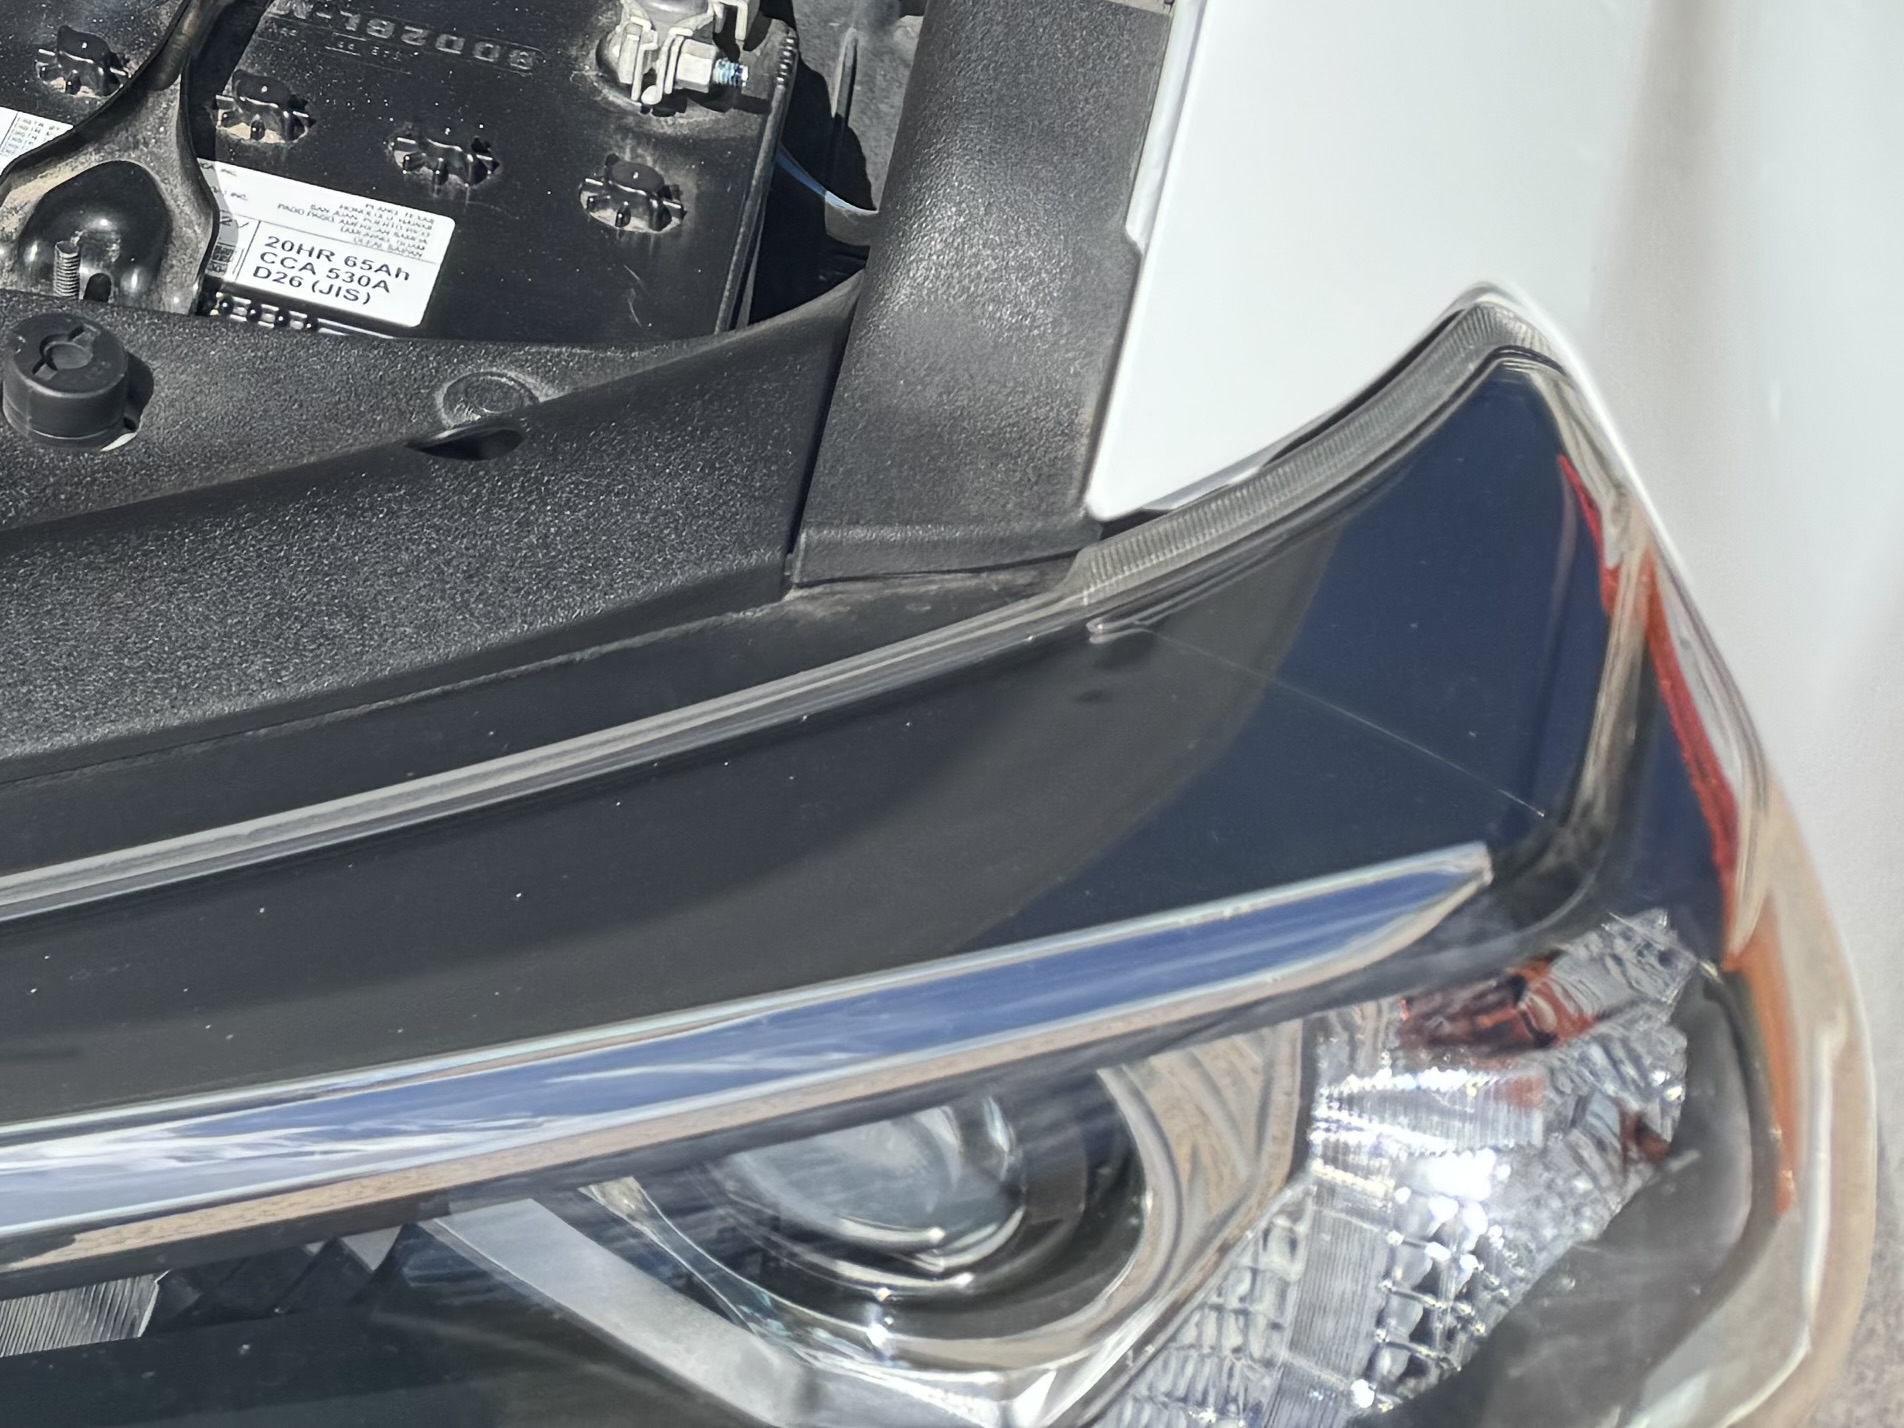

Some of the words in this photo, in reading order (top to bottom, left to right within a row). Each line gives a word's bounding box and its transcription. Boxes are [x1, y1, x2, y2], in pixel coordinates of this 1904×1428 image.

[260, 251, 316, 275] CCA
[326, 267, 390, 293] 530A
[265, 236, 336, 263] 20HR
[344, 255, 410, 281] 65Ah
[252, 265, 304, 289] D26
[311, 279, 371, 305] (JIS)
